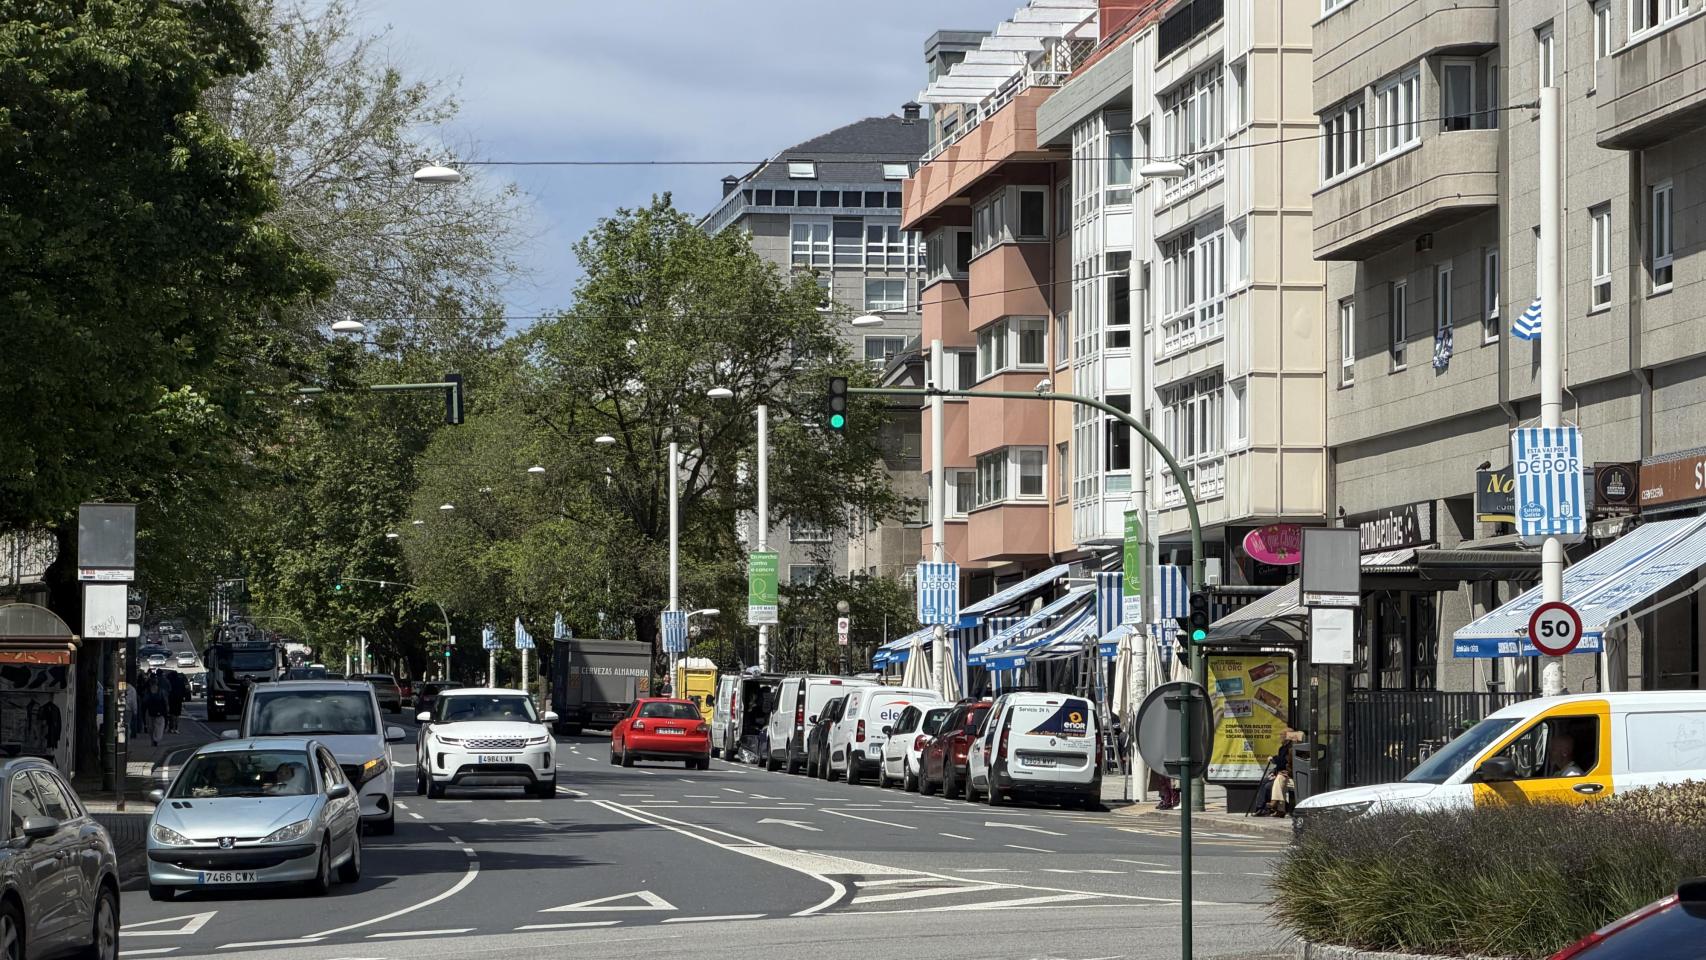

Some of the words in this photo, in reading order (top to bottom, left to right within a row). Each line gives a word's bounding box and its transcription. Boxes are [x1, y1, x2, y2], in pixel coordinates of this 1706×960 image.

[1540, 620, 1570, 638] 50
[581, 667, 613, 676] CERVEZAS
[614, 667, 649, 677] ALHAMBRA
[206, 872, 232, 882] 7466
[235, 872, 255, 882] CWX
